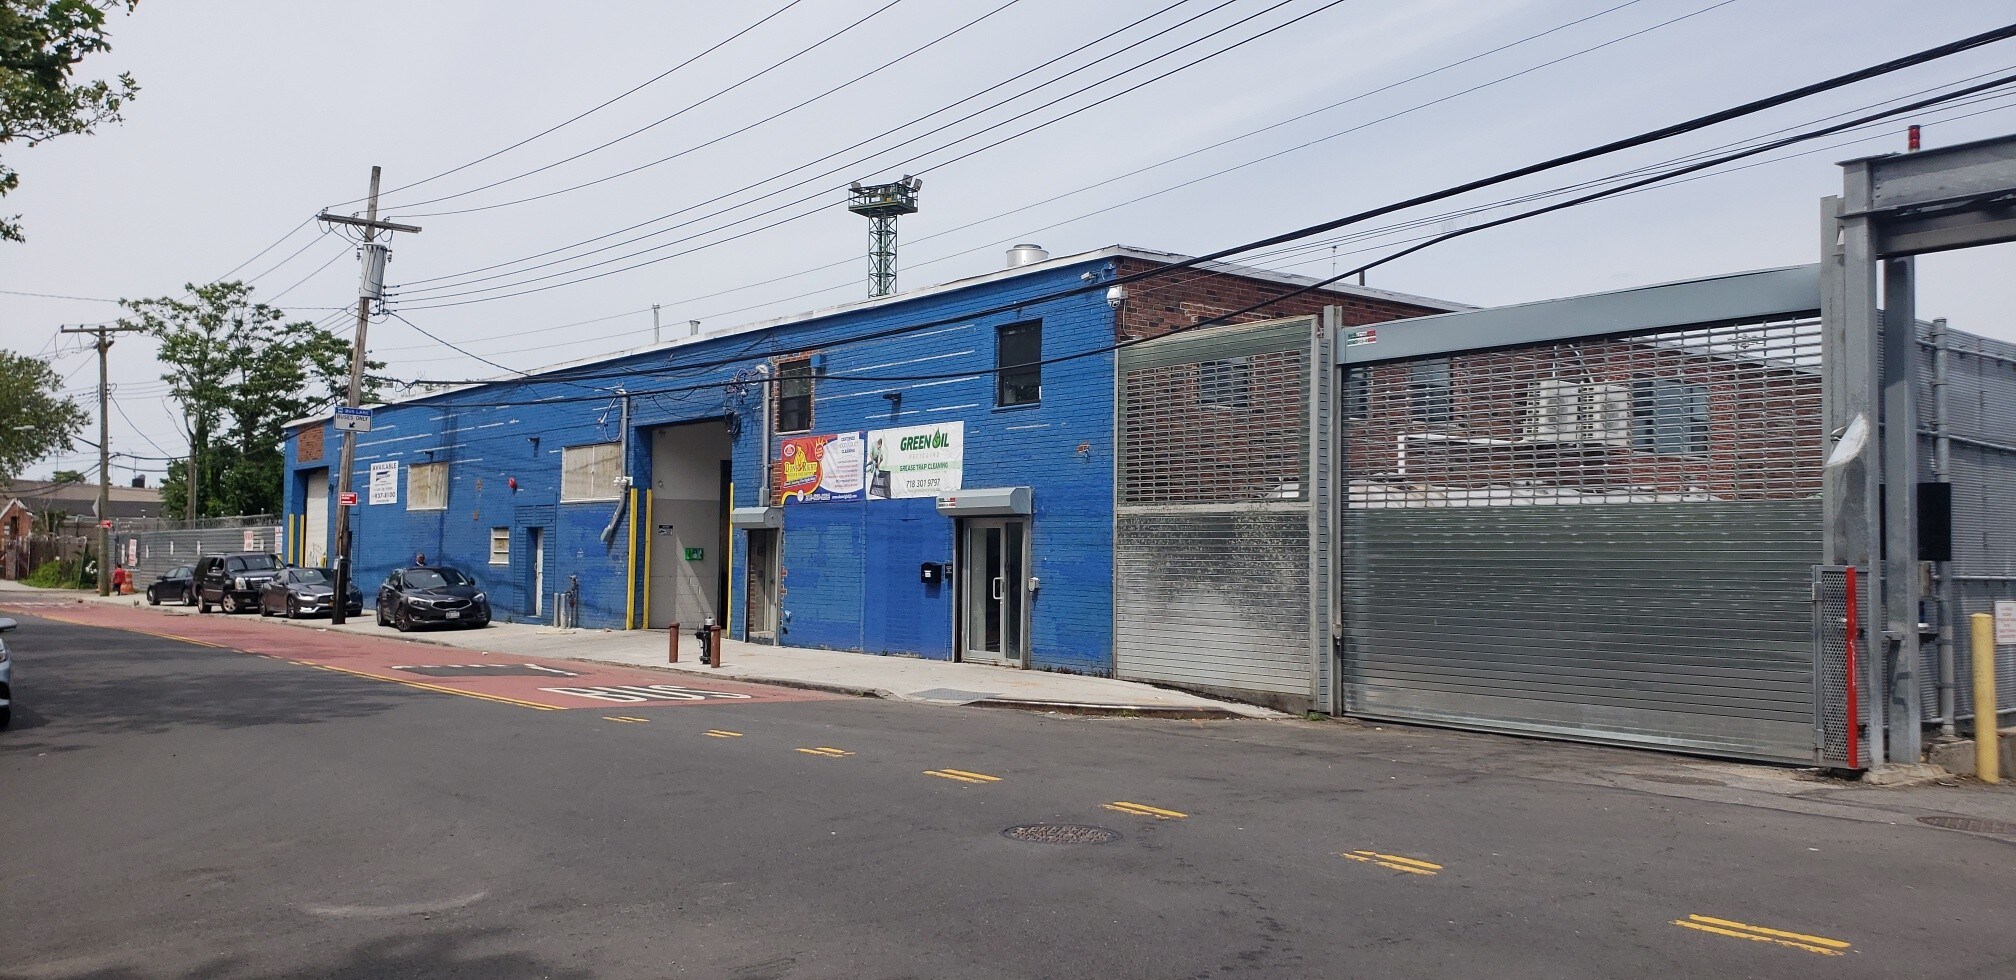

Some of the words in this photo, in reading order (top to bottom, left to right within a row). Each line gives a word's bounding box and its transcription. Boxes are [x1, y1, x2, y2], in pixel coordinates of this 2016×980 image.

[900, 434, 932, 451] GREEN
[372, 462, 397, 470] AVAILABLE
[900, 464, 916, 472] GREASE
[916, 463, 928, 471] TRAP
[928, 461, 949, 470] CLEANING
[906, 480, 916, 488] 718
[916, 479, 927, 488] 301
[927, 478, 941, 487] 9797
[538, 684, 752, 703] BUS
